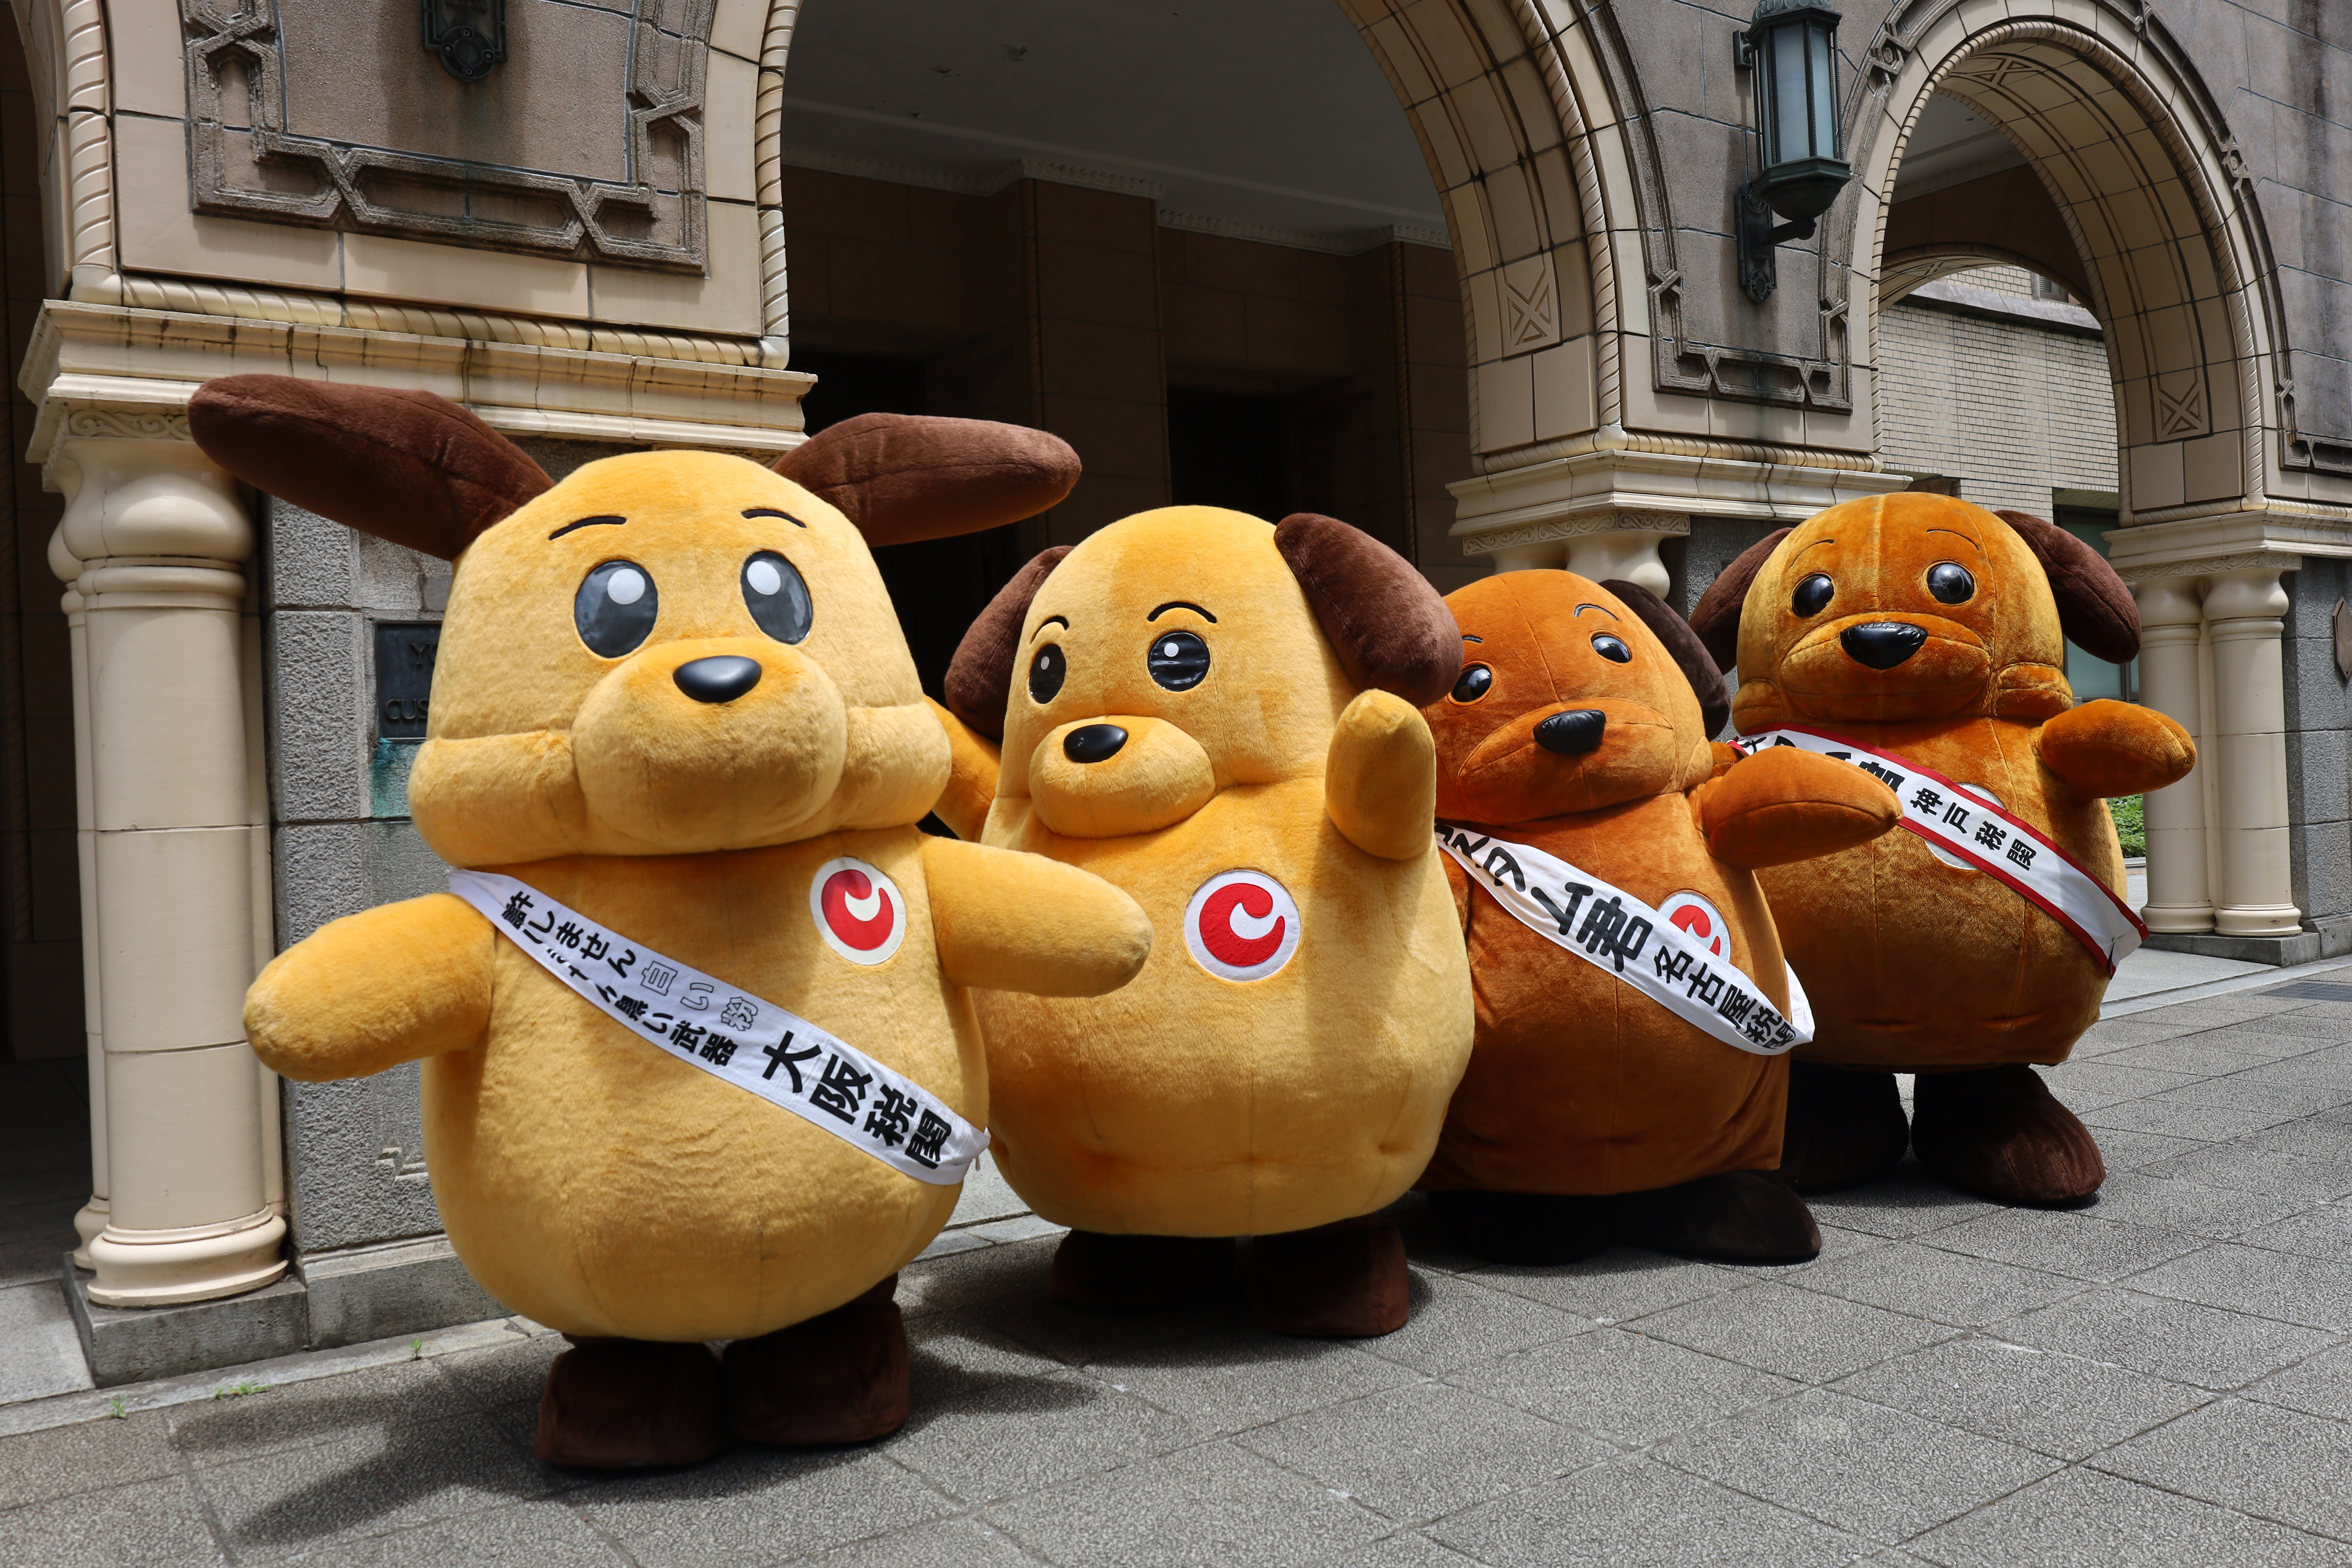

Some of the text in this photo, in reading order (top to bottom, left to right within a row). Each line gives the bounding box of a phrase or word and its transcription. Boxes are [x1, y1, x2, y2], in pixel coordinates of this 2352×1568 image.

[1910, 788, 2036, 871] 神戸税関
[1654, 945, 1795, 1049] 名古屋税関
[763, 1031, 951, 1170] 大阪税関
